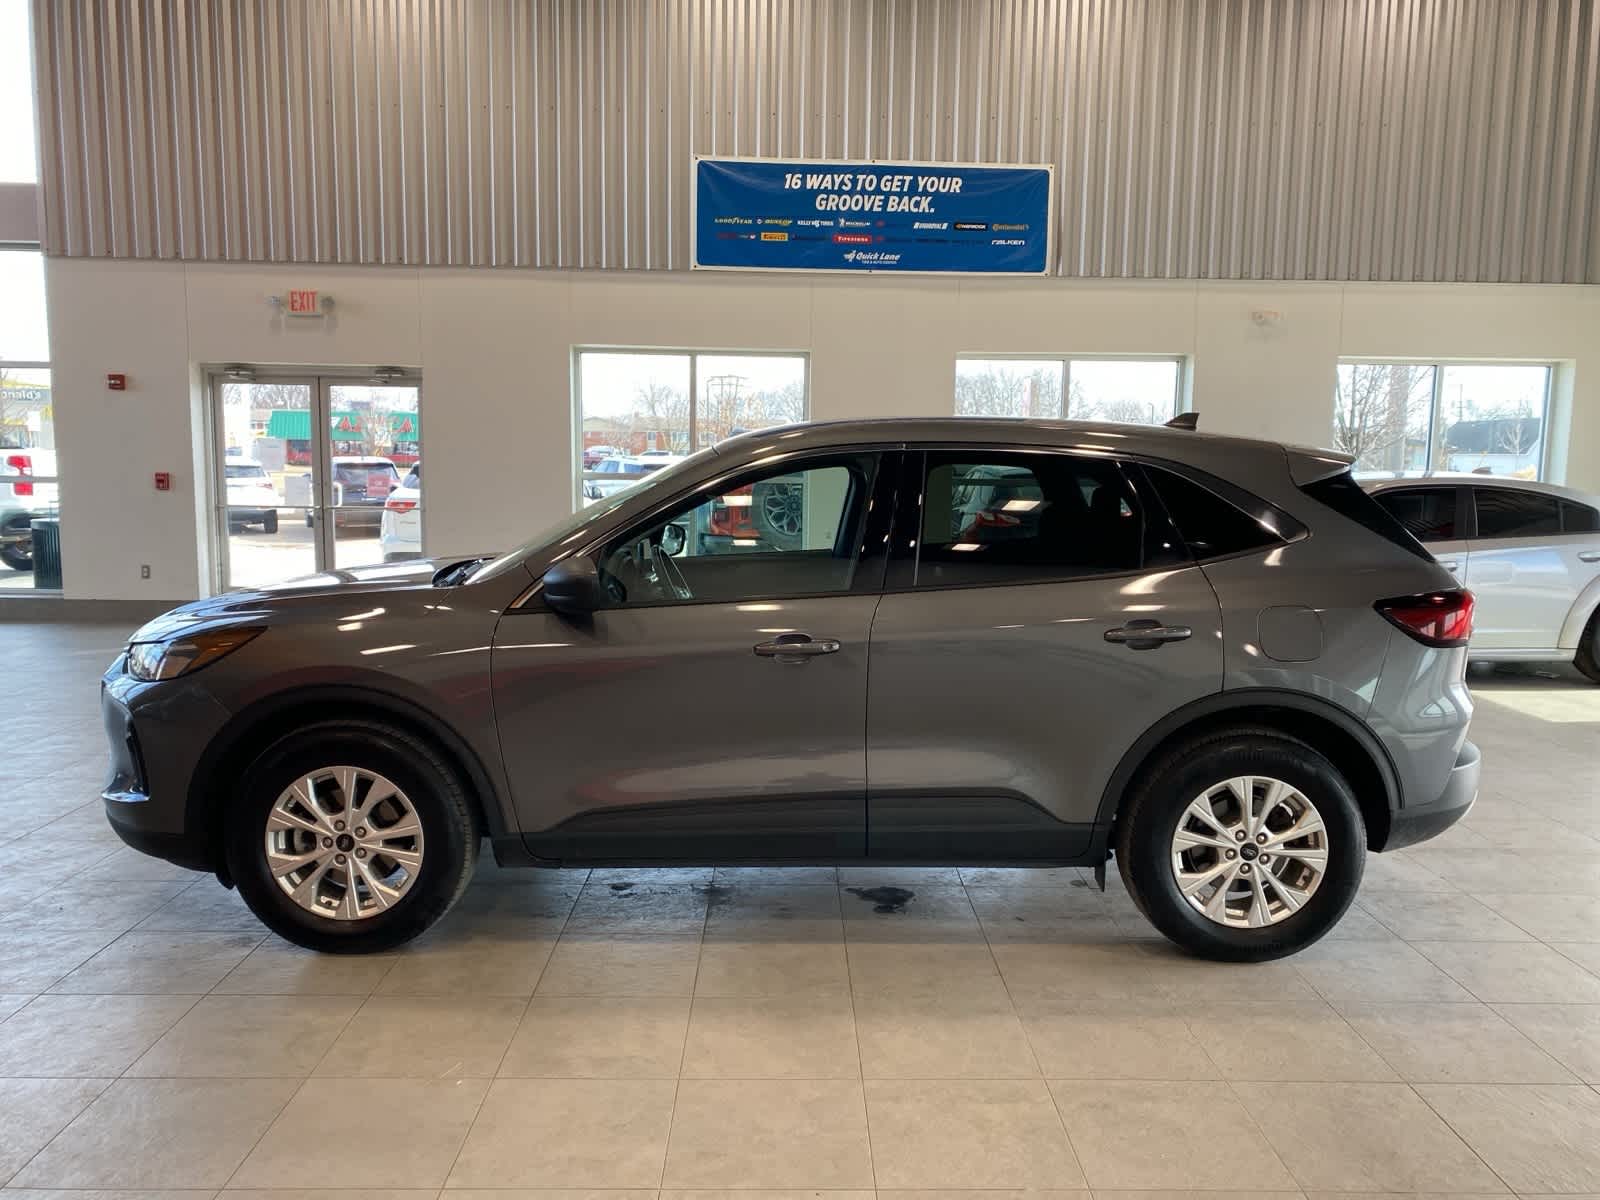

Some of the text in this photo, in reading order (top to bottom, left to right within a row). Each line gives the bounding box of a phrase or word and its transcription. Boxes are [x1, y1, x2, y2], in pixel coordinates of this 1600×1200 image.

[784, 173, 962, 193] 16 WAYS TO GET YOUR
[815, 194, 935, 213] GROOVE BACK.
[856, 251, 901, 261] Quick Lane
[290, 289, 318, 312] EXIT
